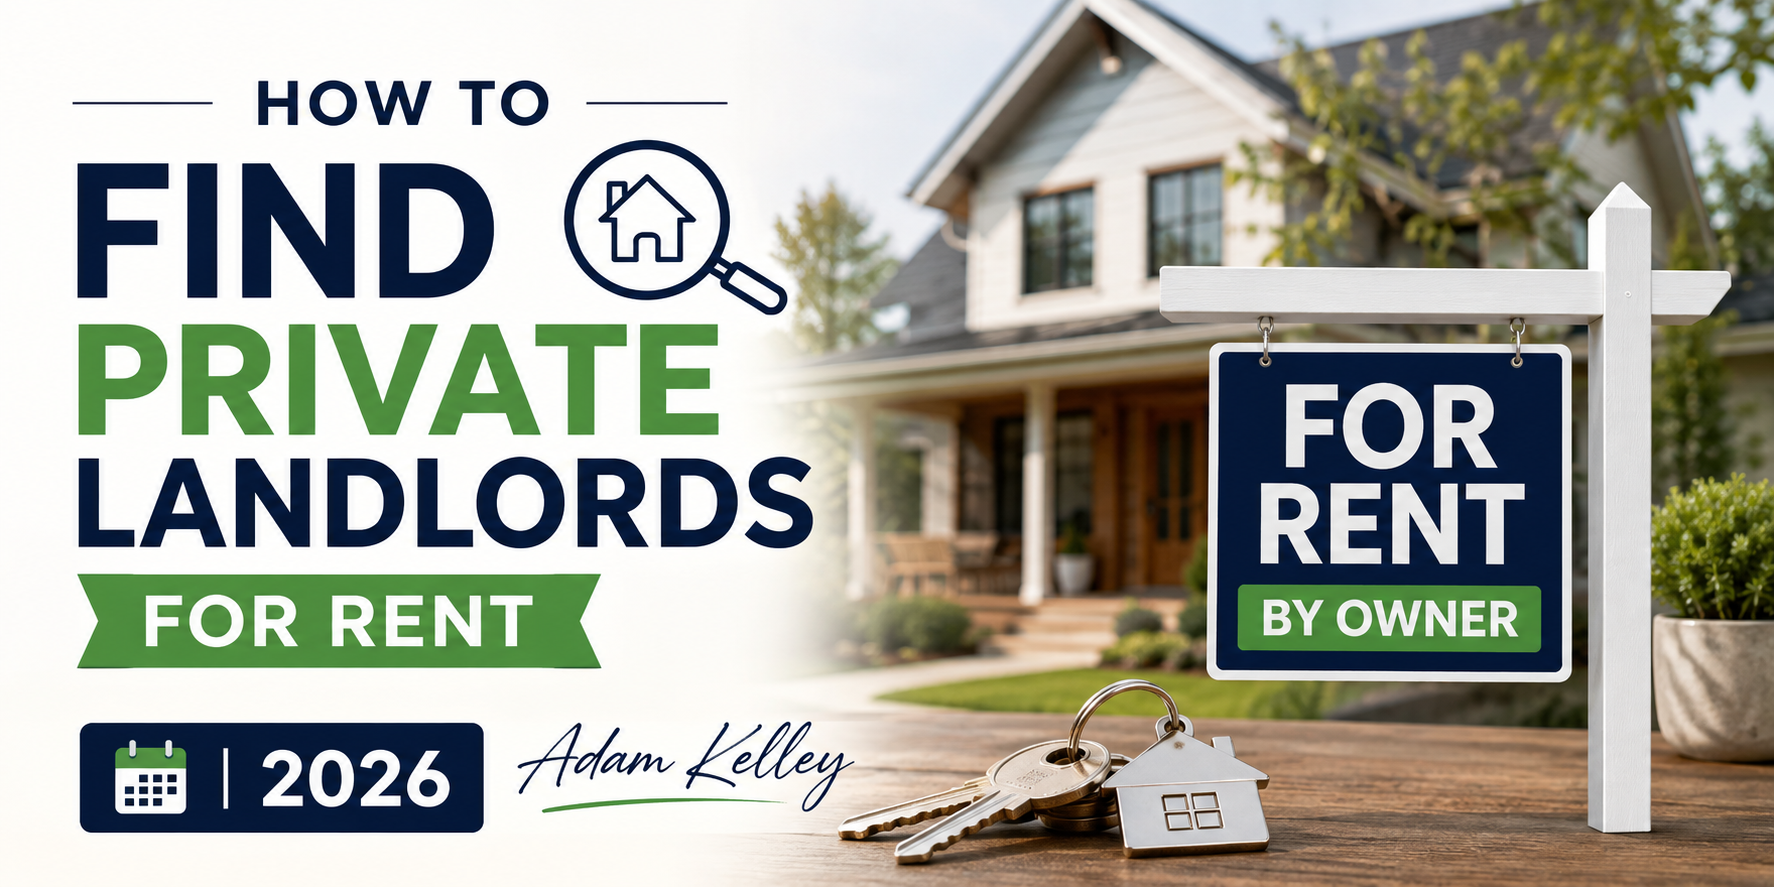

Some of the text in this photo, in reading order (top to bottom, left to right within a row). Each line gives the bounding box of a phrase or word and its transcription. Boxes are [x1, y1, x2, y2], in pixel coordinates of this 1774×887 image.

[1285, 382, 1498, 470] FOR
[1260, 482, 1525, 565] RENT
[1263, 599, 1519, 637] BY OWNER
